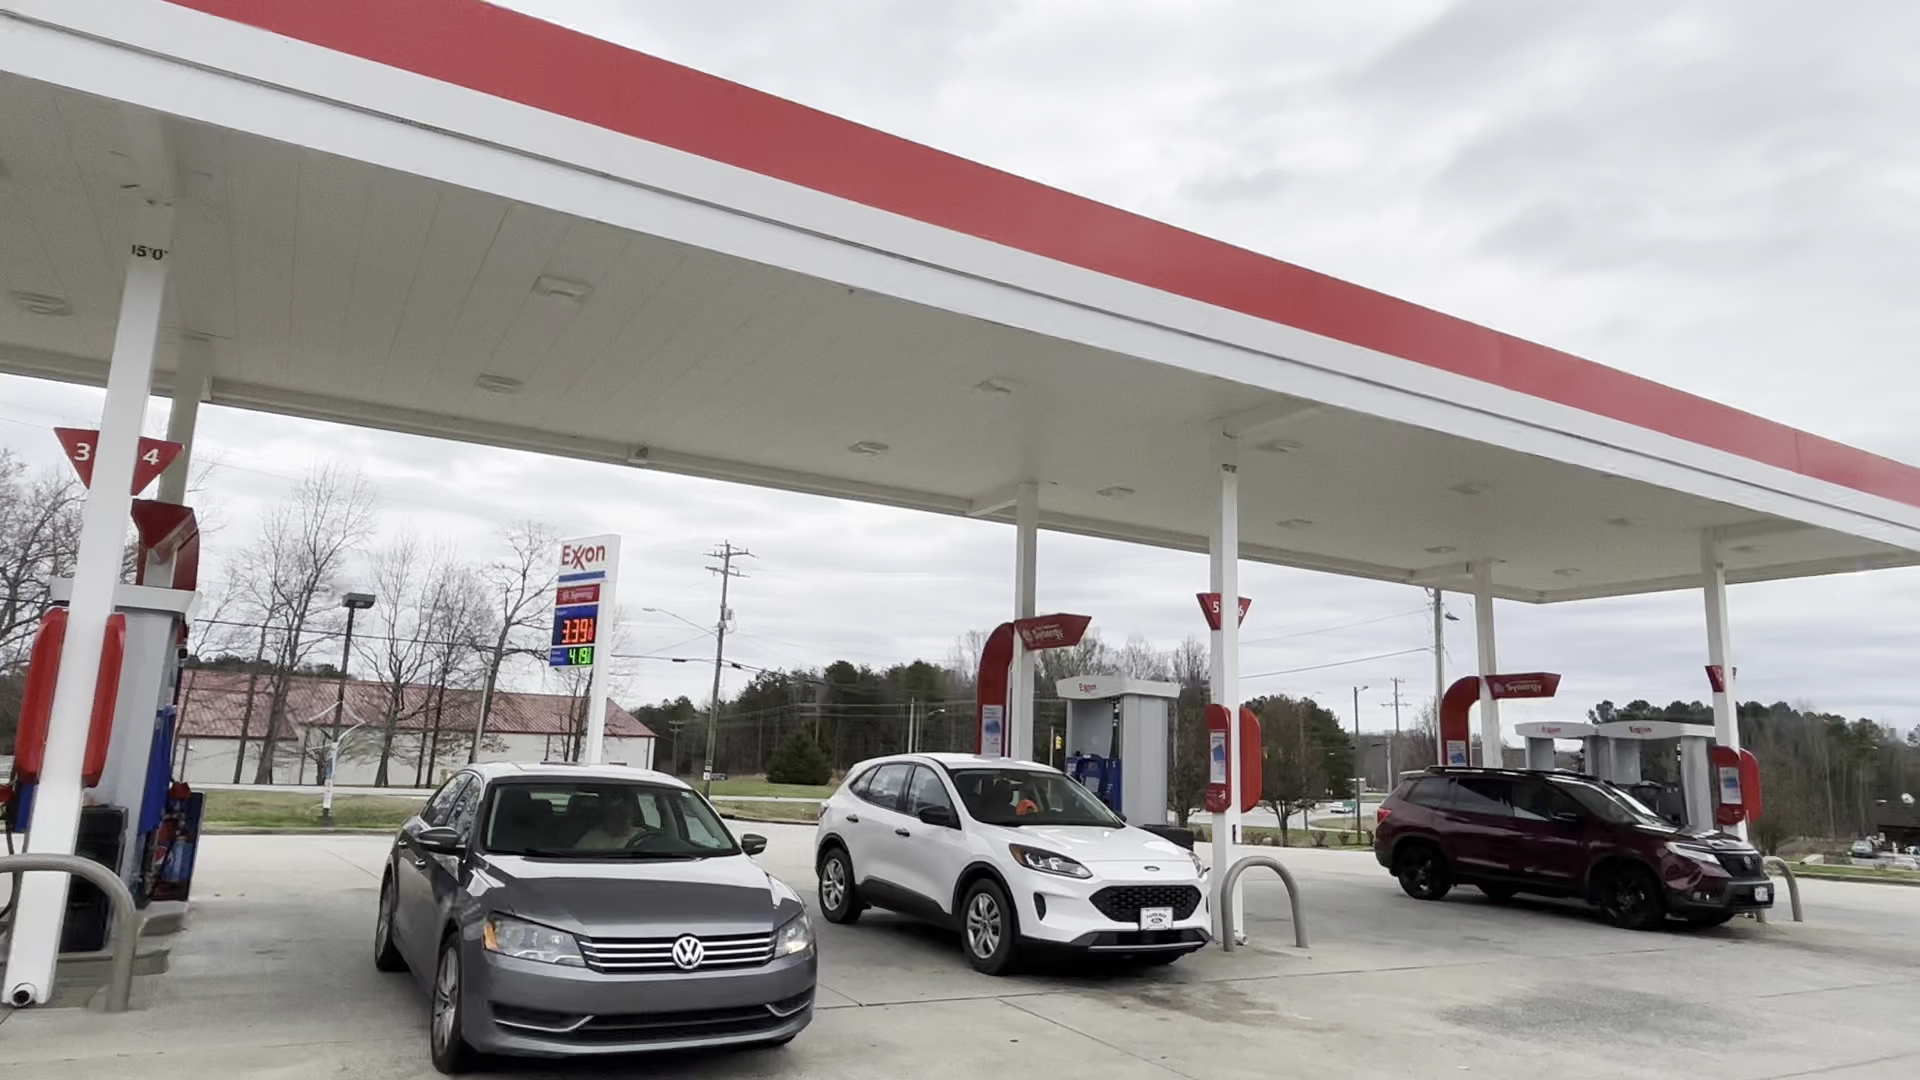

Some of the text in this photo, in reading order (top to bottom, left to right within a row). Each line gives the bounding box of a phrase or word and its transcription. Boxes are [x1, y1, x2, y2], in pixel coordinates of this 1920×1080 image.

[73, 442, 91, 461] 3
[141, 448, 160, 466] 4
[561, 544, 605, 570] Exxon
[1212, 600, 1220, 614] 5
